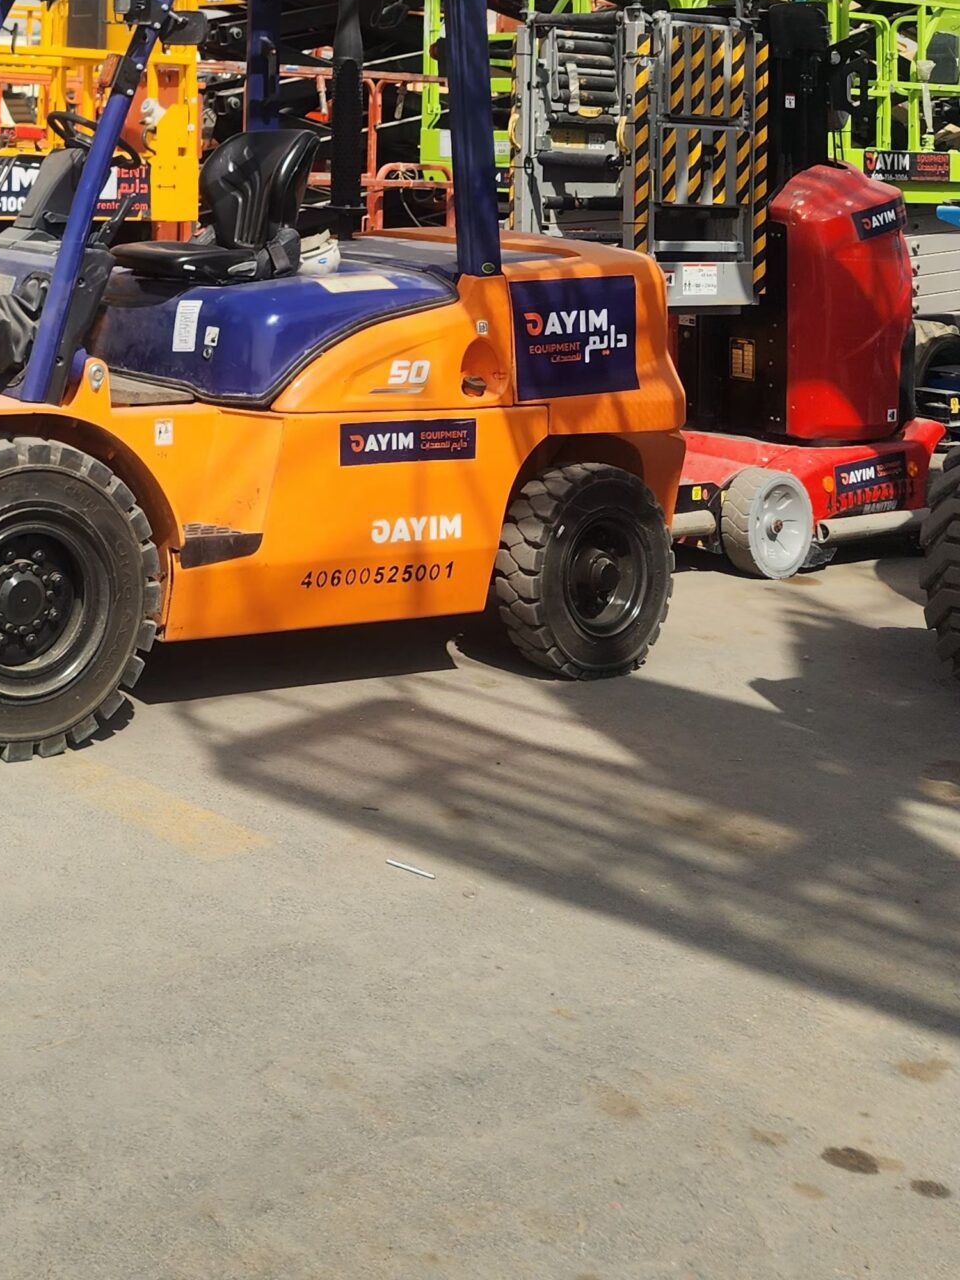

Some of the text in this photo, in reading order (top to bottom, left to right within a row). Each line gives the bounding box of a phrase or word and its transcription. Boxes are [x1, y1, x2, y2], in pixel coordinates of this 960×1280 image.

[865, 151, 910, 171] DAYIM
[862, 208, 897, 230] DAYIM
[524, 308, 608, 336] DAYIM
[528, 341, 581, 354] EQUIPMENT
[584, 324, 628, 363] دايم
[388, 359, 431, 385] 50
[349, 431, 414, 453] DAYIM
[420, 430, 468, 440] EQUIPMENT
[840, 466, 875, 485] DAYIM
[370, 513, 462, 544] DAYIM
[300, 561, 455, 589] 40600525001
